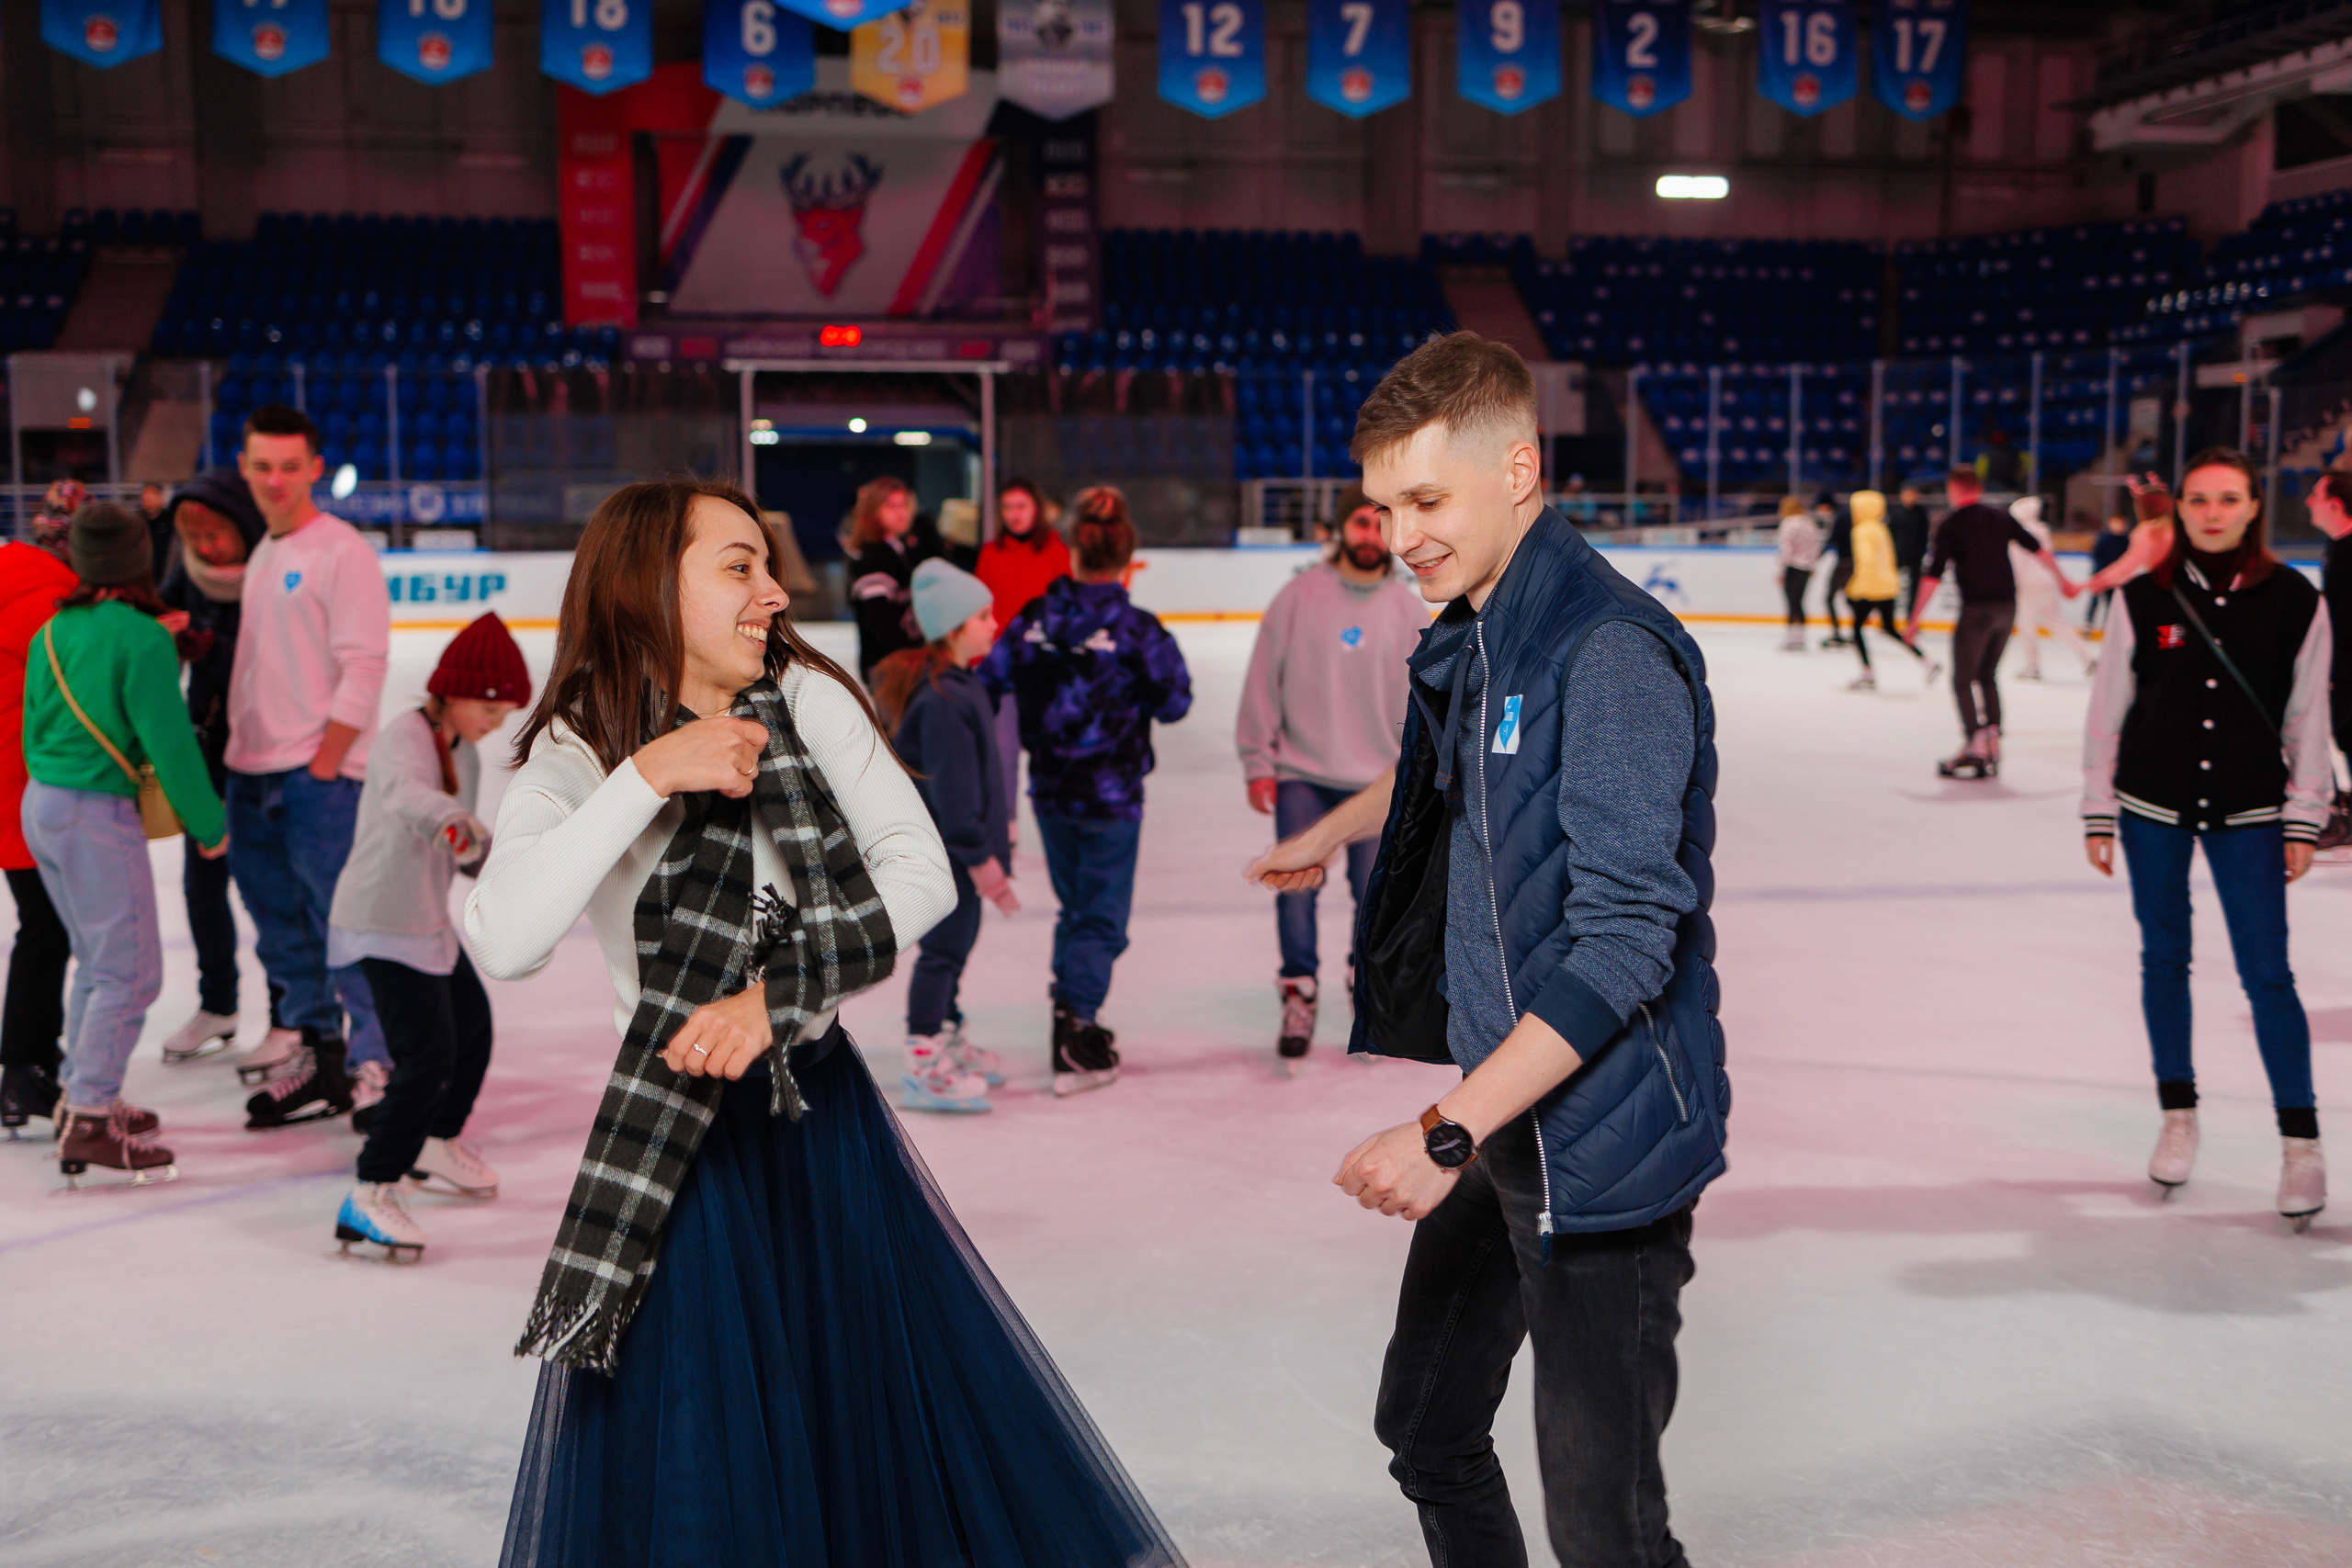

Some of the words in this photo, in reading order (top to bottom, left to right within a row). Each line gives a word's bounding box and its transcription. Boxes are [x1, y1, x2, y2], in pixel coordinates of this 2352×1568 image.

[741, 0, 777, 57] 6
[876, 26, 941, 75] 20
[1182, 4, 1243, 57] 12
[1341, 4, 1374, 56] 7
[1490, 0, 1525, 53] 9
[1626, 11, 1659, 68] 2
[1781, 11, 1838, 65] 16
[1893, 18, 1946, 73] 17
